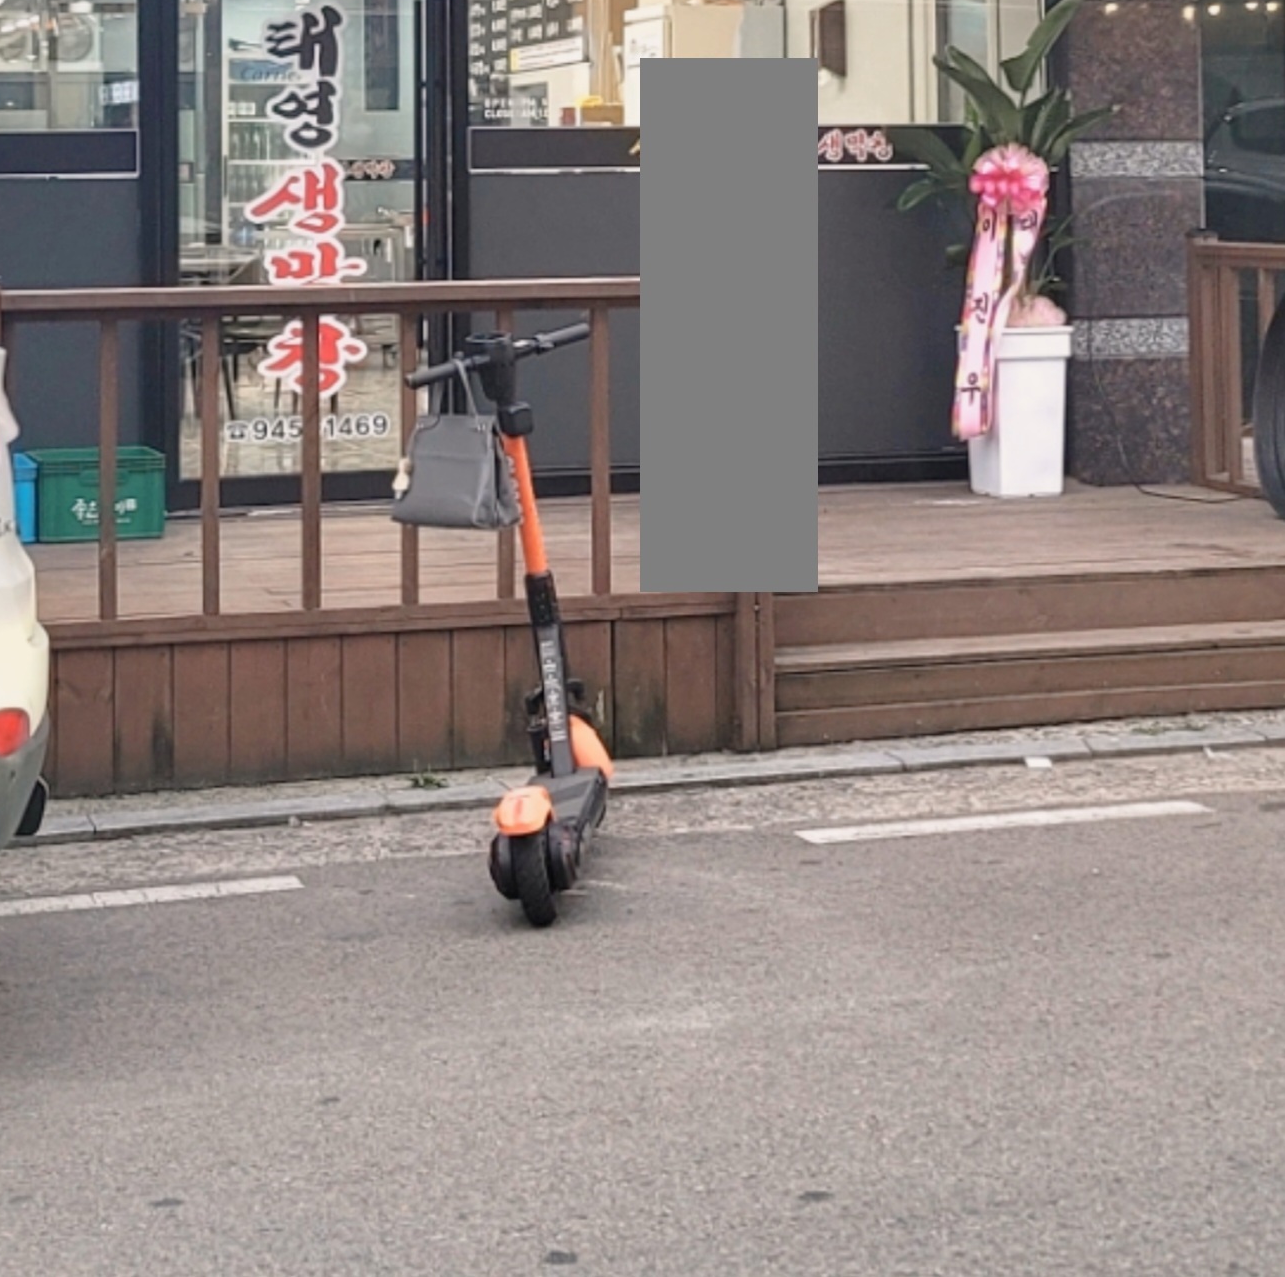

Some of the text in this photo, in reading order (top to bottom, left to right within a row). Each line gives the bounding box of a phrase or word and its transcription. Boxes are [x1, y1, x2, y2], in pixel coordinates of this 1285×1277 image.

[247, 1, 367, 398] 태영 생막창
[252, 415, 389, 440] 9451469
